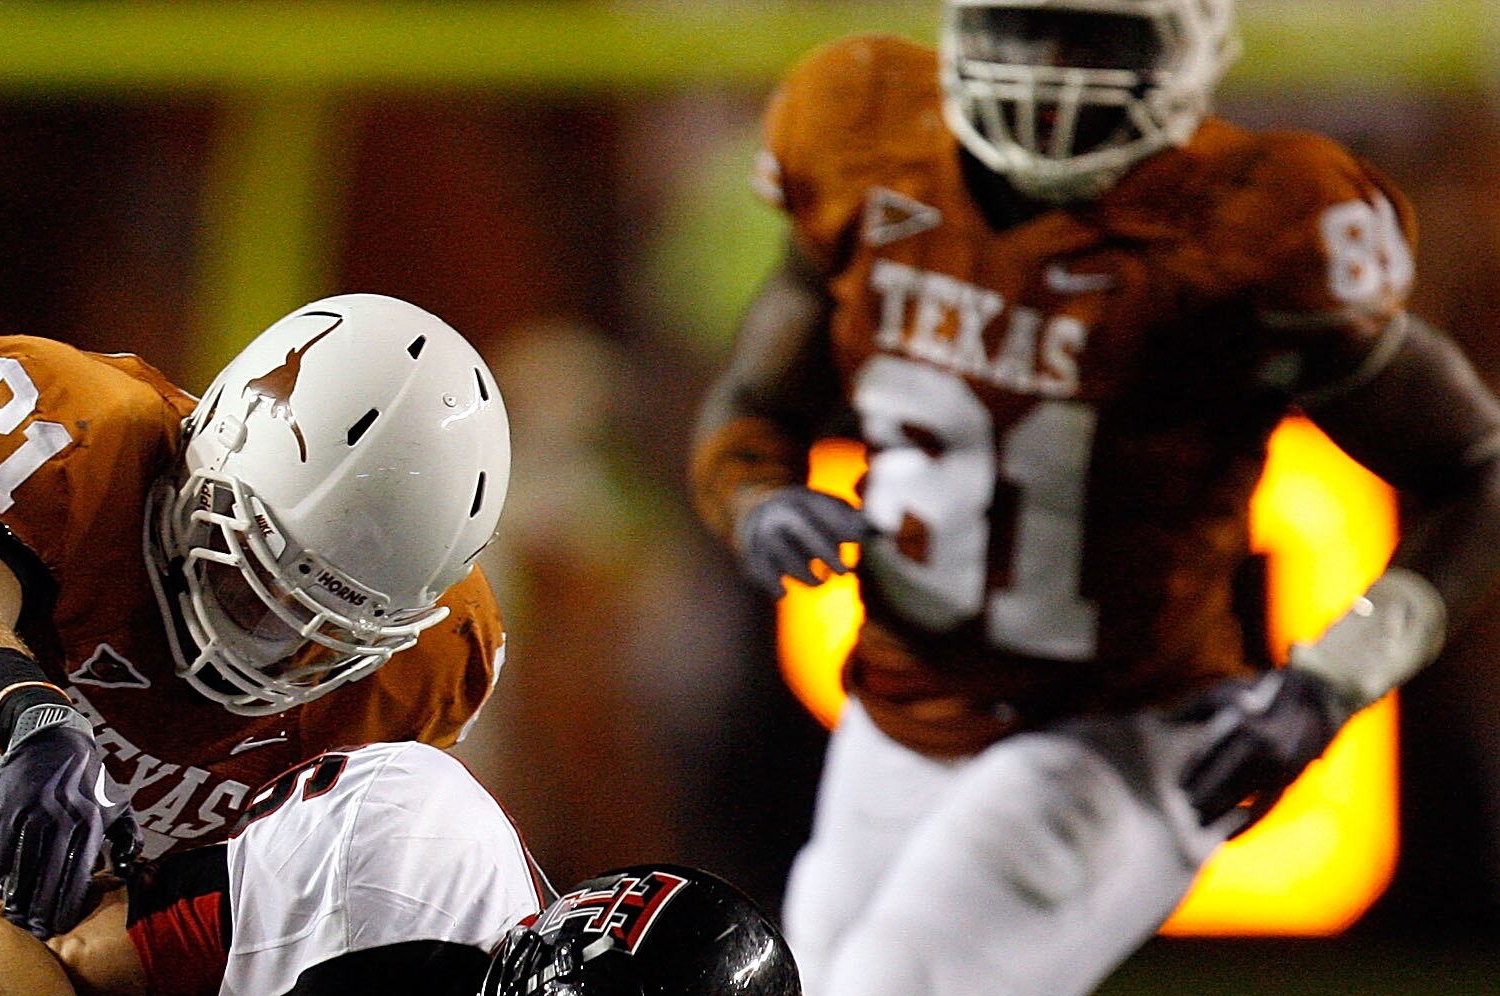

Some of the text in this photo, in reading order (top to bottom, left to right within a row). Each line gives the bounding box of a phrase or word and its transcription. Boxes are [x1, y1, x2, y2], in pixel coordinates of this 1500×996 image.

[871, 257, 1088, 397] TEXAS
[254, 513, 275, 538] NIKE
[854, 352, 1100, 662] 81
[317, 569, 368, 607] HORNS
